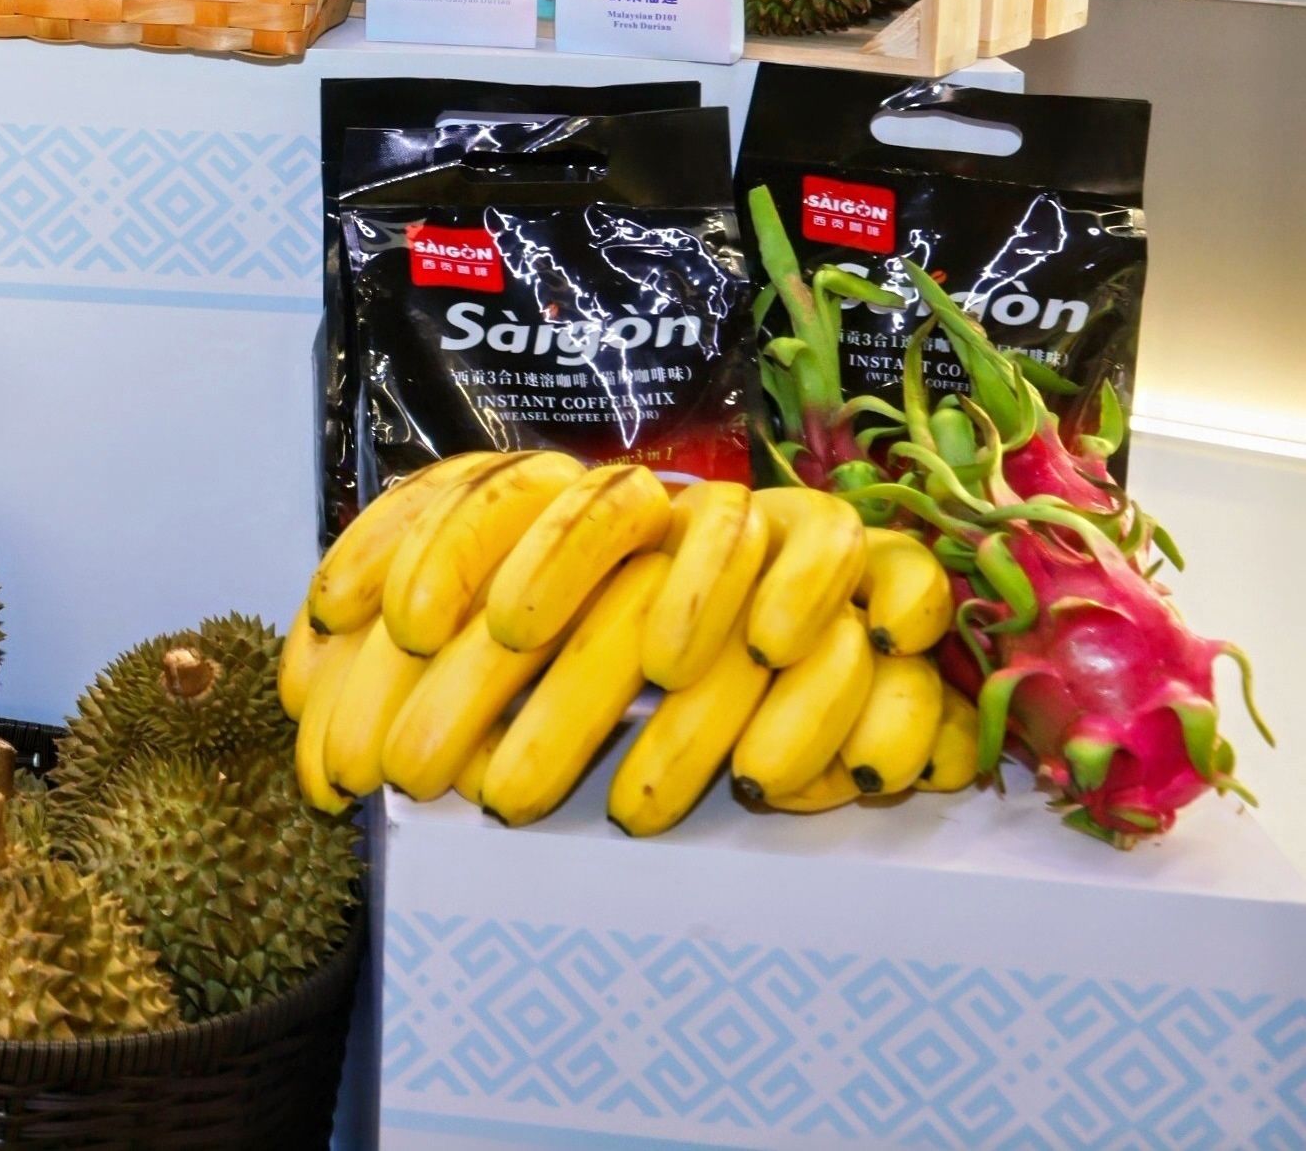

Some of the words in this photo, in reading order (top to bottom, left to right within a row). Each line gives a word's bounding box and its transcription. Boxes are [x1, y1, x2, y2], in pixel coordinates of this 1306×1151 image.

[607, 11, 653, 20] Malaysian
[655, 13, 677, 22] D101
[613, 21, 637, 29] Fresh
[813, 214, 881, 238] 西贡咖啡
[421, 258, 489, 277] 西贡咖啡
[848, 353, 933, 375] INSTAT
[476, 394, 556, 410] INSTANT
[562, 395, 633, 410] COFFEE
[638, 392, 675, 407] MIX
[556, 411, 601, 423] COFFEE
